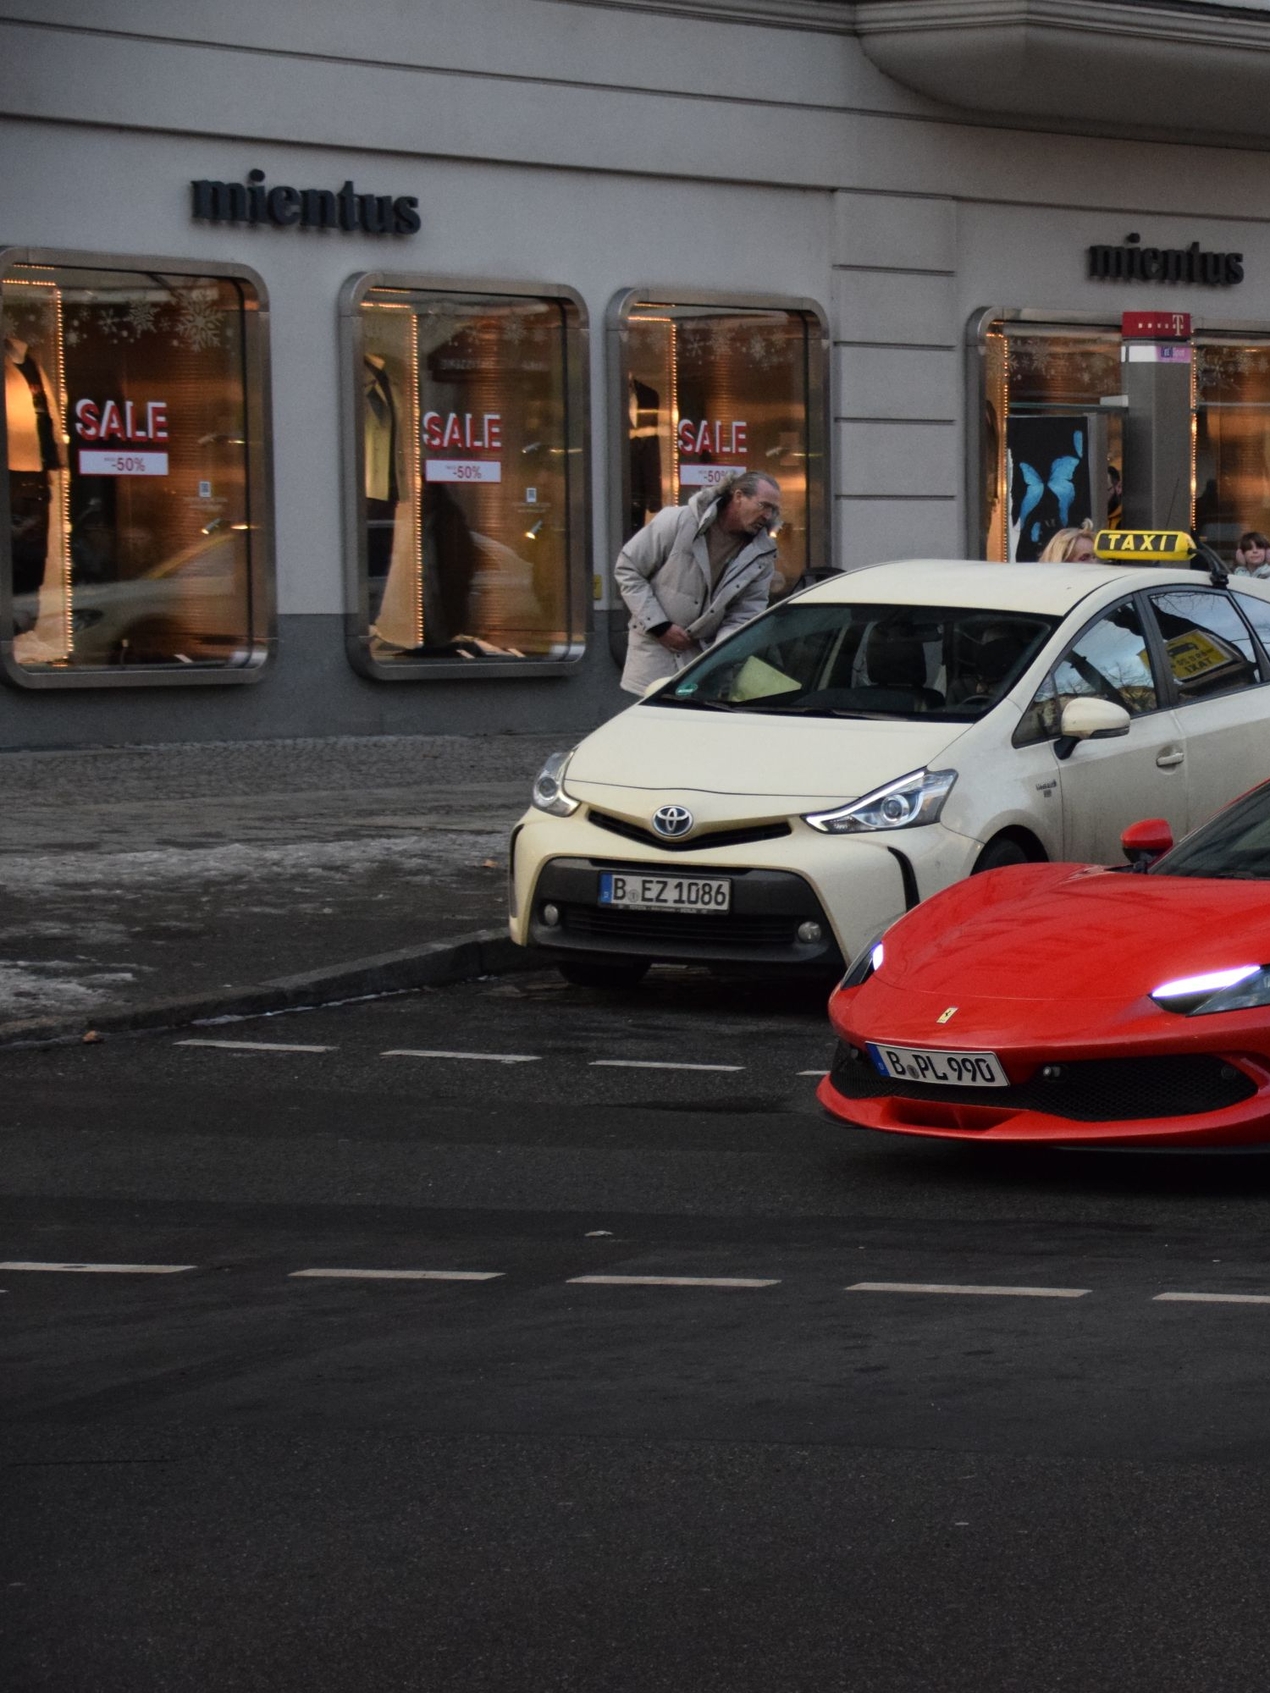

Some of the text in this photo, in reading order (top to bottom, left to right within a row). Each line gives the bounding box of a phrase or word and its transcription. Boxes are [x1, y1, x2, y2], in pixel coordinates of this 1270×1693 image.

[191, 168, 421, 235] mientus
[1089, 233, 1244, 285] mientus
[75, 398, 170, 442] SALE
[422, 411, 503, 451] SALE
[678, 418, 748, 456] SALE
[111, 457, 146, 472] -50%
[453, 465, 482, 479] -50%
[1108, 534, 1167, 551] TAXI
[613, 878, 726, 906] B EZ 1086
[886, 1050, 996, 1083] B PL 990
